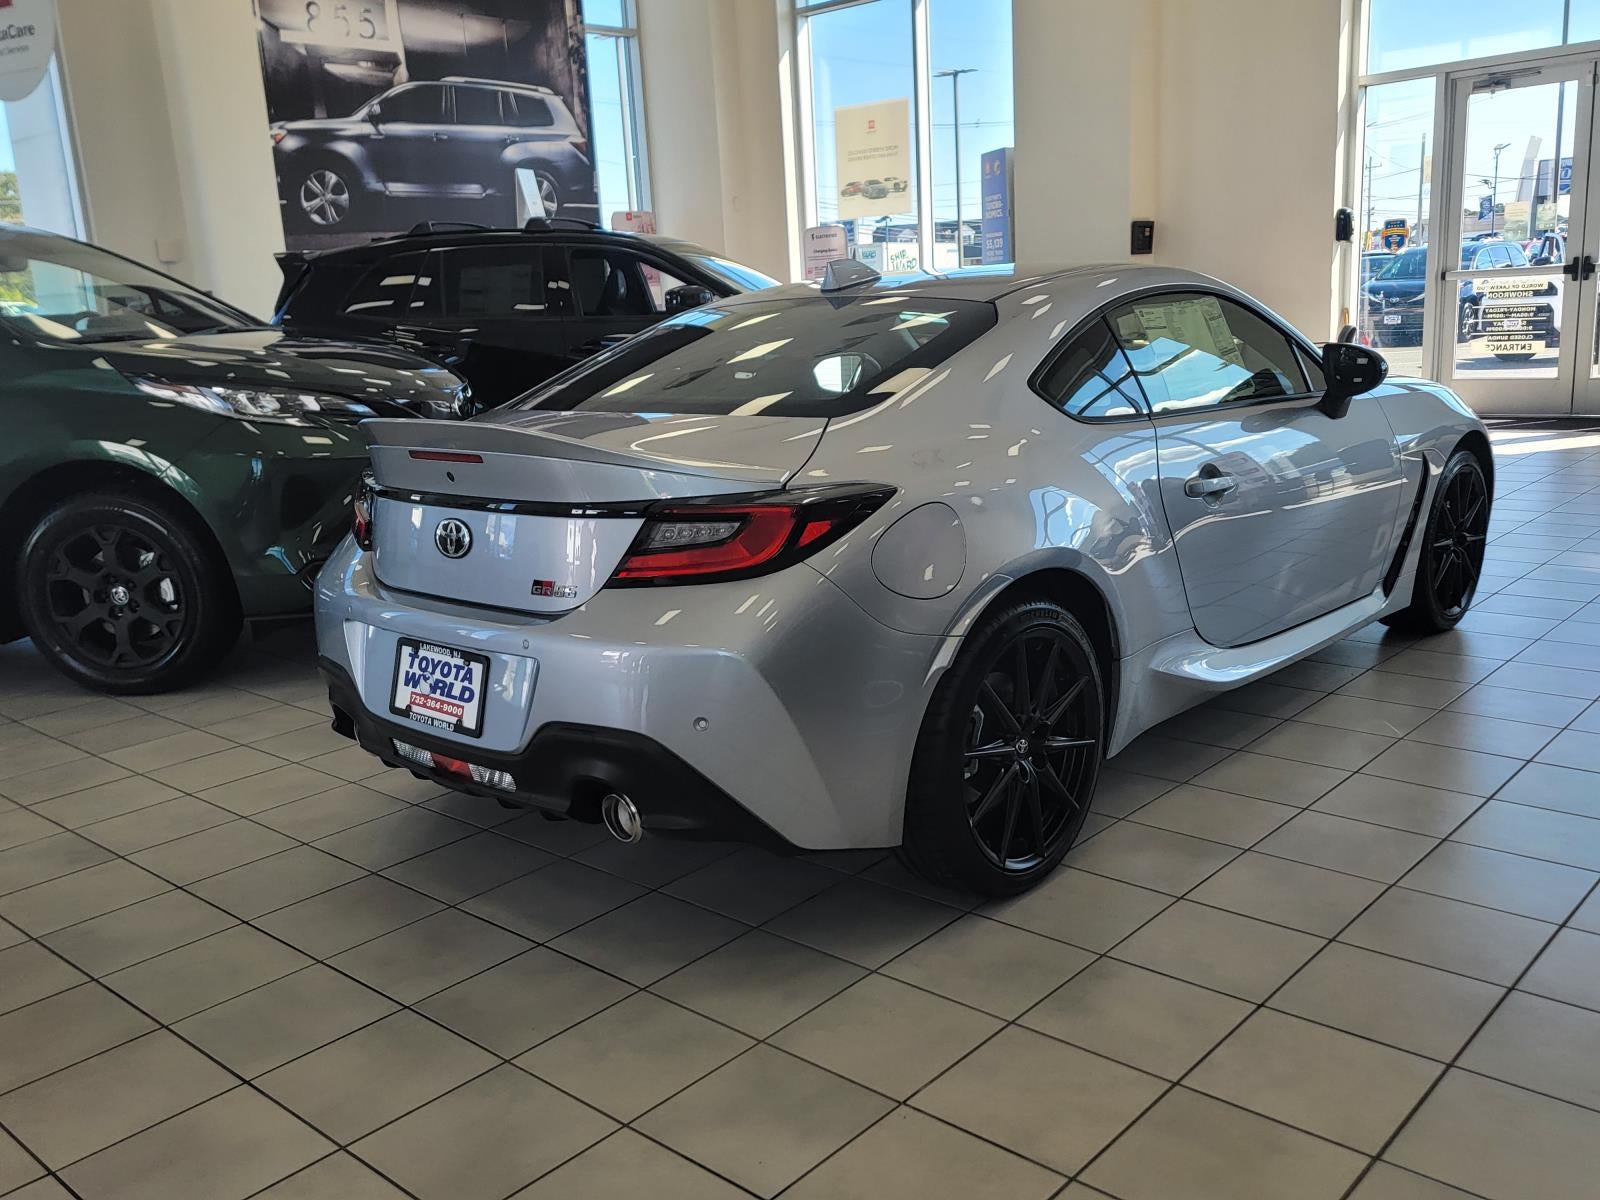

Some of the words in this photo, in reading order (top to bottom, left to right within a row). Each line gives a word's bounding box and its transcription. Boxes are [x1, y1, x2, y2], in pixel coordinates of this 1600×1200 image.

[420, 643, 453, 659] LAKEWOOD,
[453, 650, 461, 659] NJ
[408, 651, 473, 685] TOYOTA
[411, 694, 463, 716] 732-364-9000
[409, 712, 432, 726] TOYOTA
[433, 719, 454, 732] WORLD
